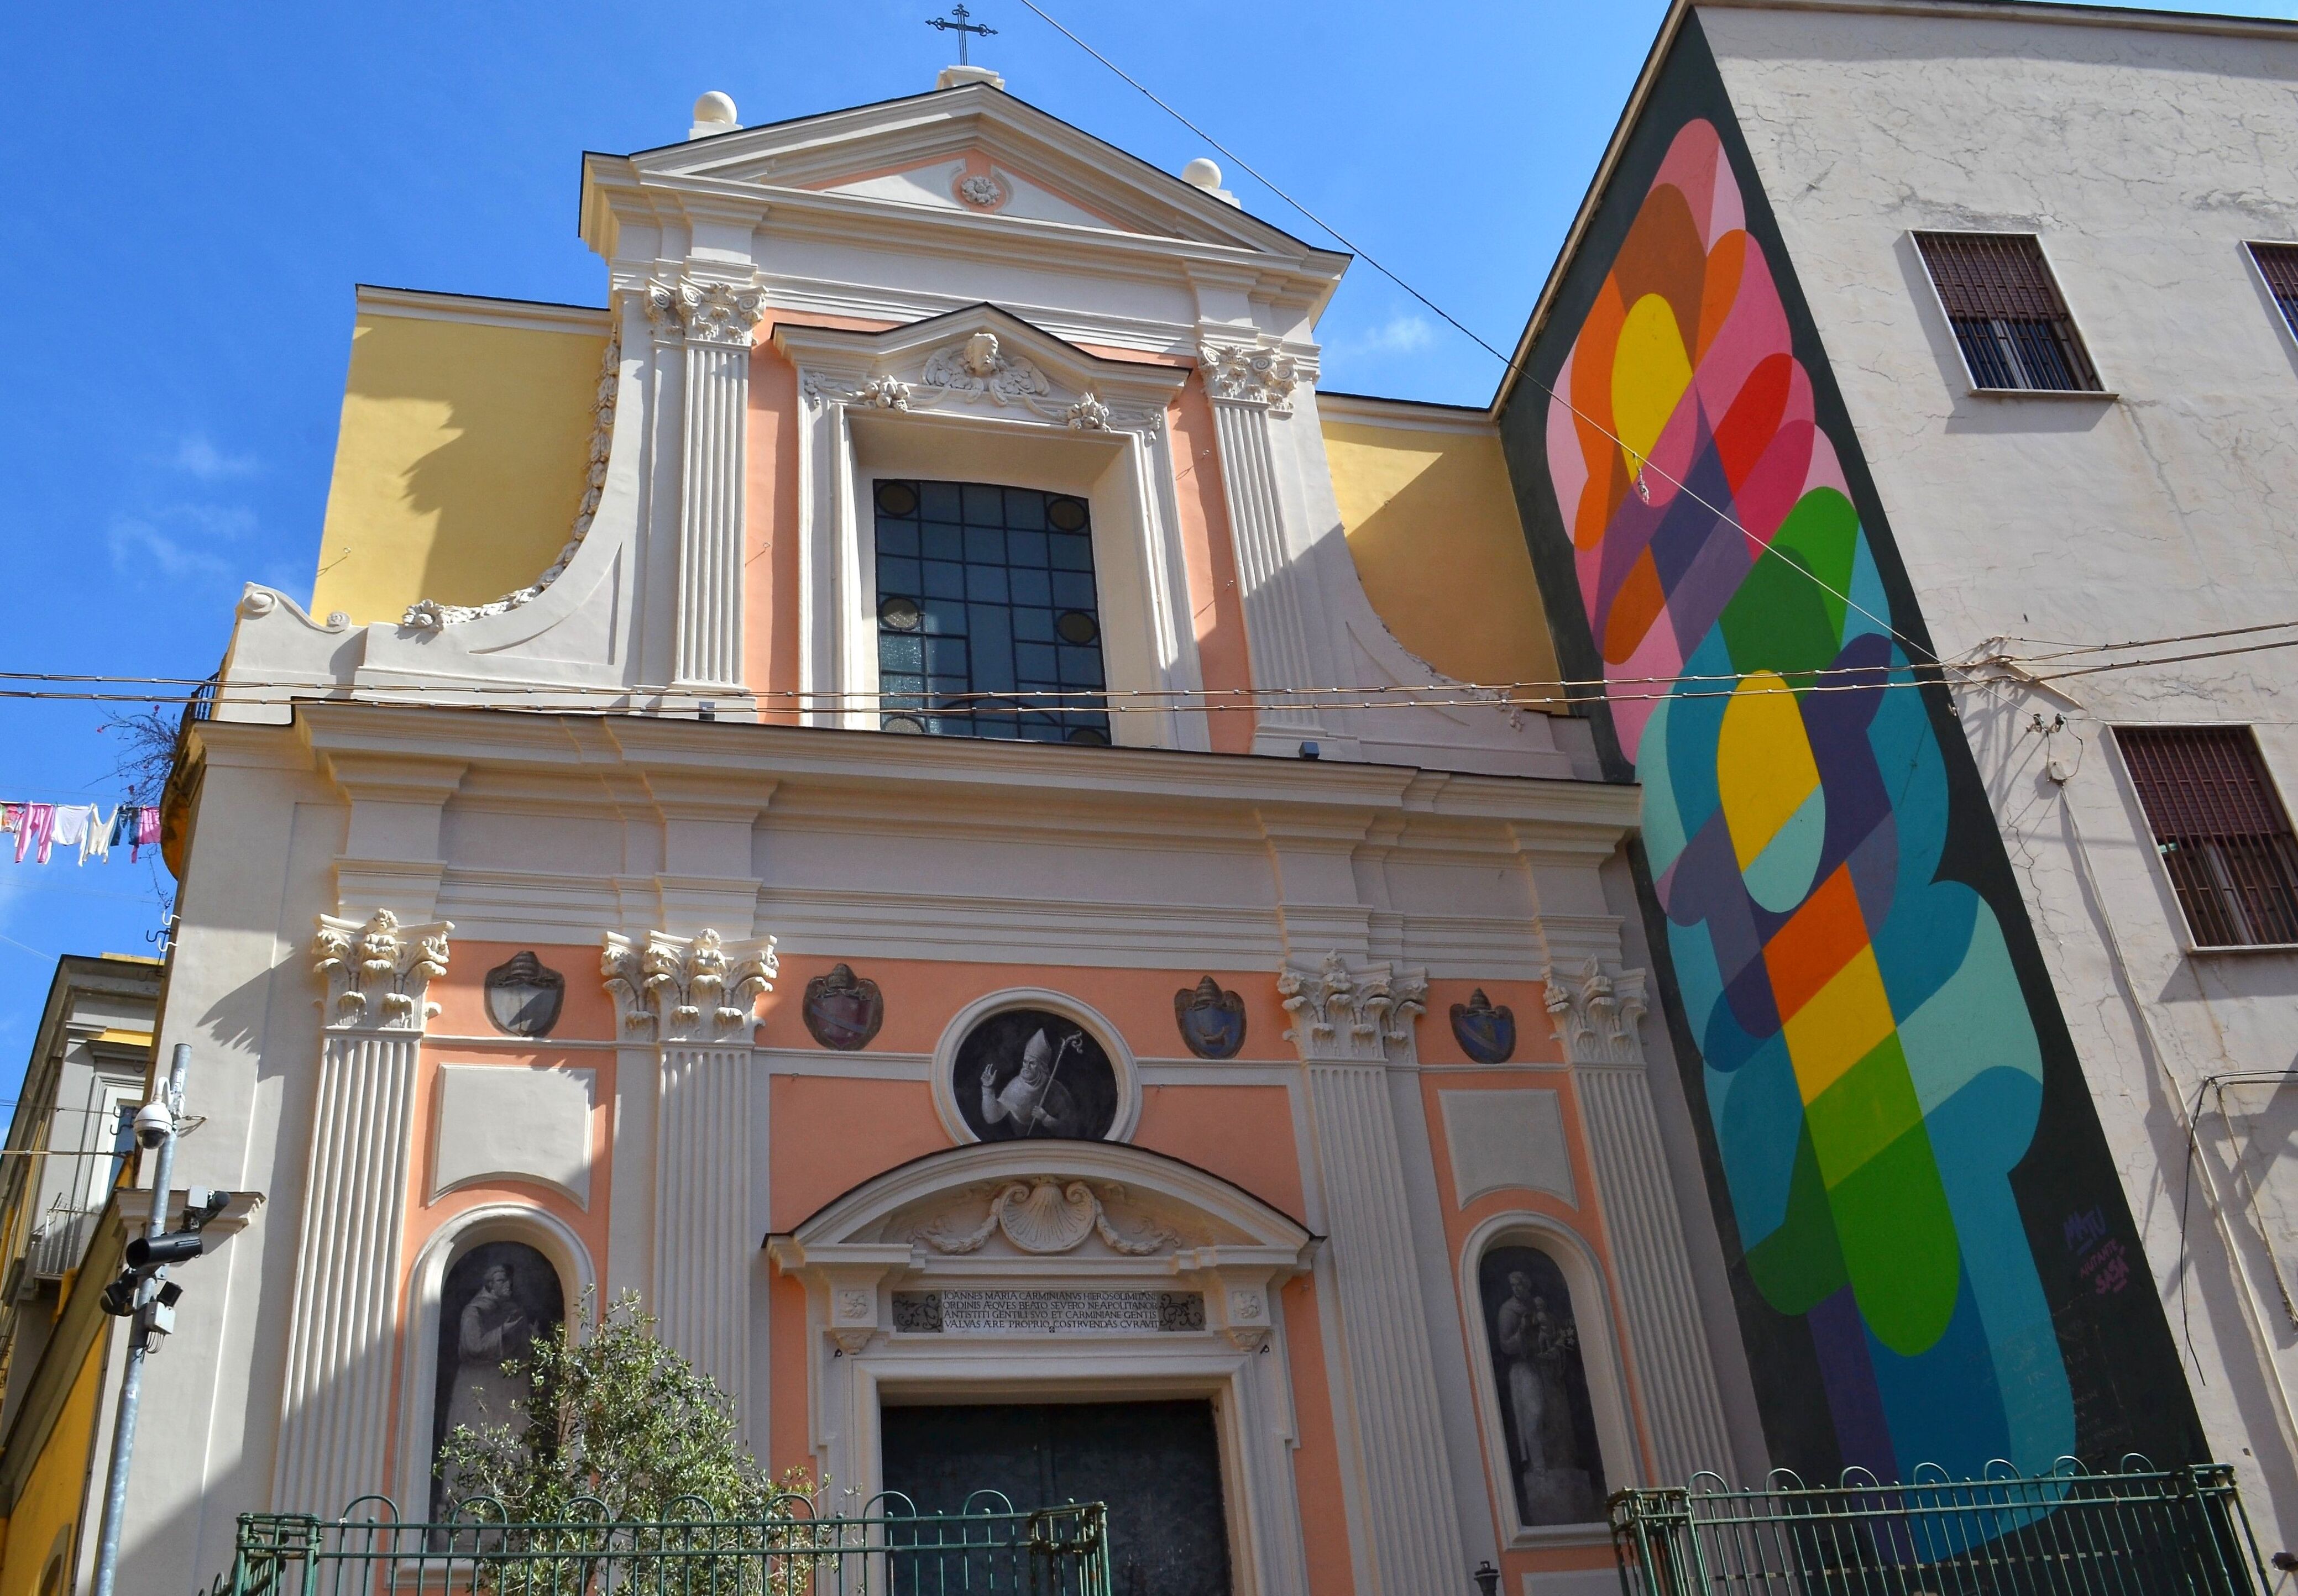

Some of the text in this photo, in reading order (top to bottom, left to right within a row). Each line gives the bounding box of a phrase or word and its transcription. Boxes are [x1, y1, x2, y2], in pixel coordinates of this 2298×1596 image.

[985, 1292, 1017, 1300] MARIA
[1019, 1291, 1082, 1300] CARMINIANVS
[1083, 1292, 1156, 1300] HIEROSOLIMITANI
[943, 1301, 981, 1309] ORDINIS
[1019, 1301, 1048, 1309] BEATO
[944, 1310, 990, 1319] ANTISTITI
[992, 1310, 1028, 1319] GENTILI
[1051, 1310, 1062, 1319] ET
[1066, 1310, 1121, 1319] CARMINIANE
[1124, 1310, 1156, 1319] GENTIS
[945, 1319, 981, 1328] VALVAS
[1009, 1320, 1050, 1328] PROPRIO
[1054, 1320, 1117, 1328] COSTRVENDAS
[1120, 1320, 1159, 1328] CVRAVIT
